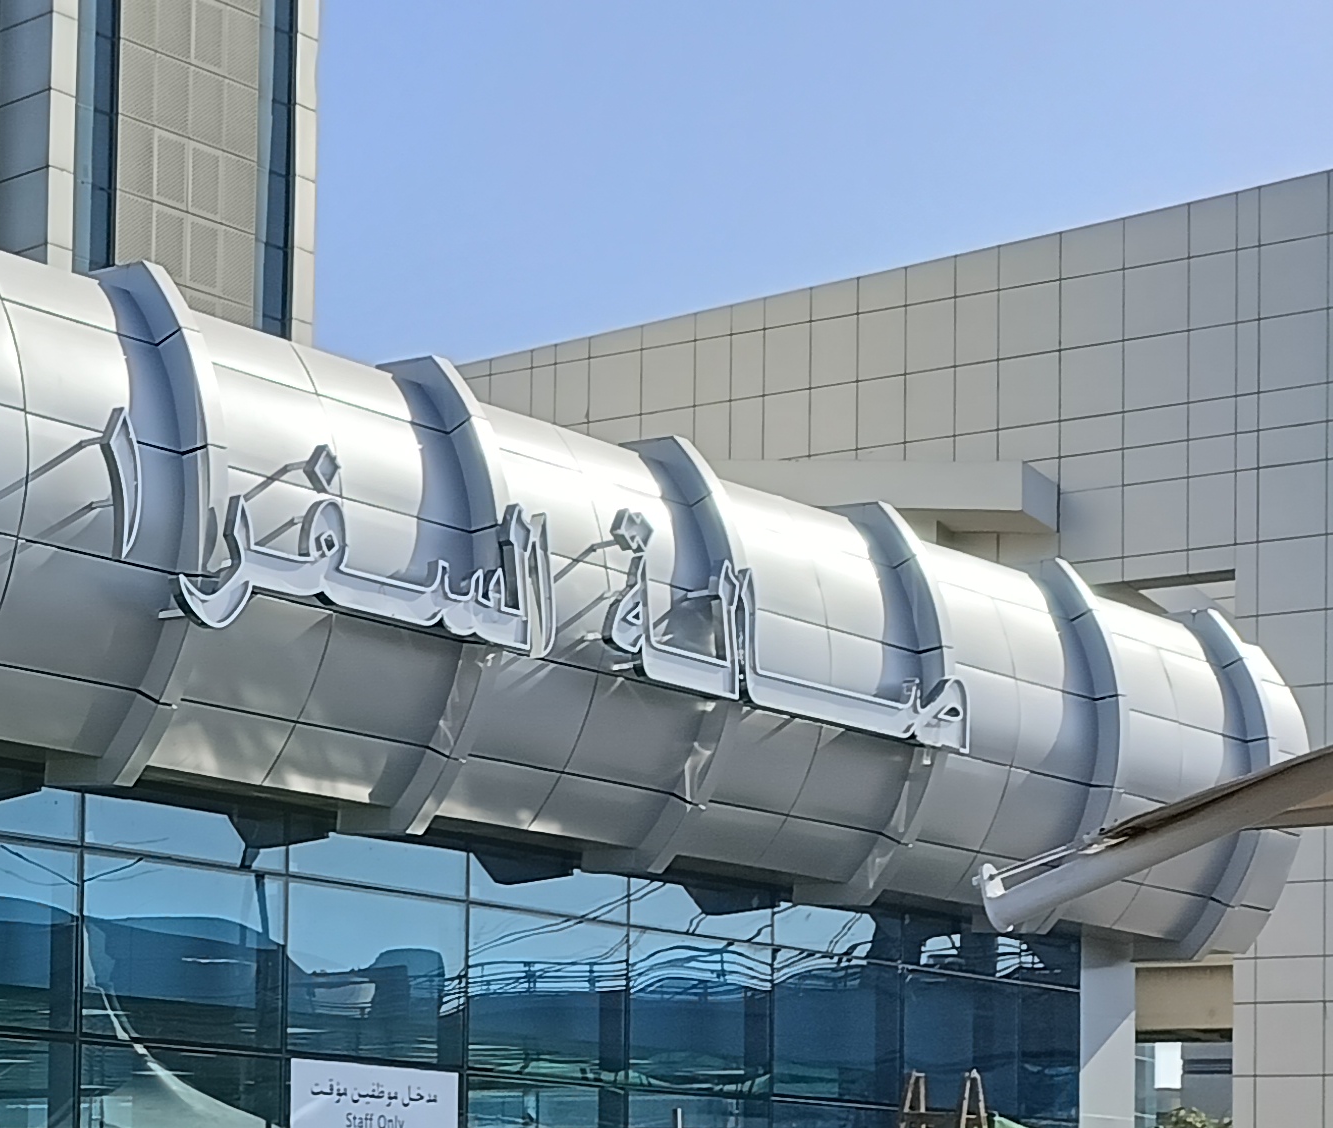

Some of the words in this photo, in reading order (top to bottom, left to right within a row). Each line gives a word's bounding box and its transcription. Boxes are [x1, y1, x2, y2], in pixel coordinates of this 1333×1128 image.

[172, 444, 555, 659] السفر
[606, 509, 969, 755] صالة
[310, 1078, 348, 1104] مؤقت
[350, 1081, 399, 1107] موظفين
[401, 1085, 438, 1107] مدخل
